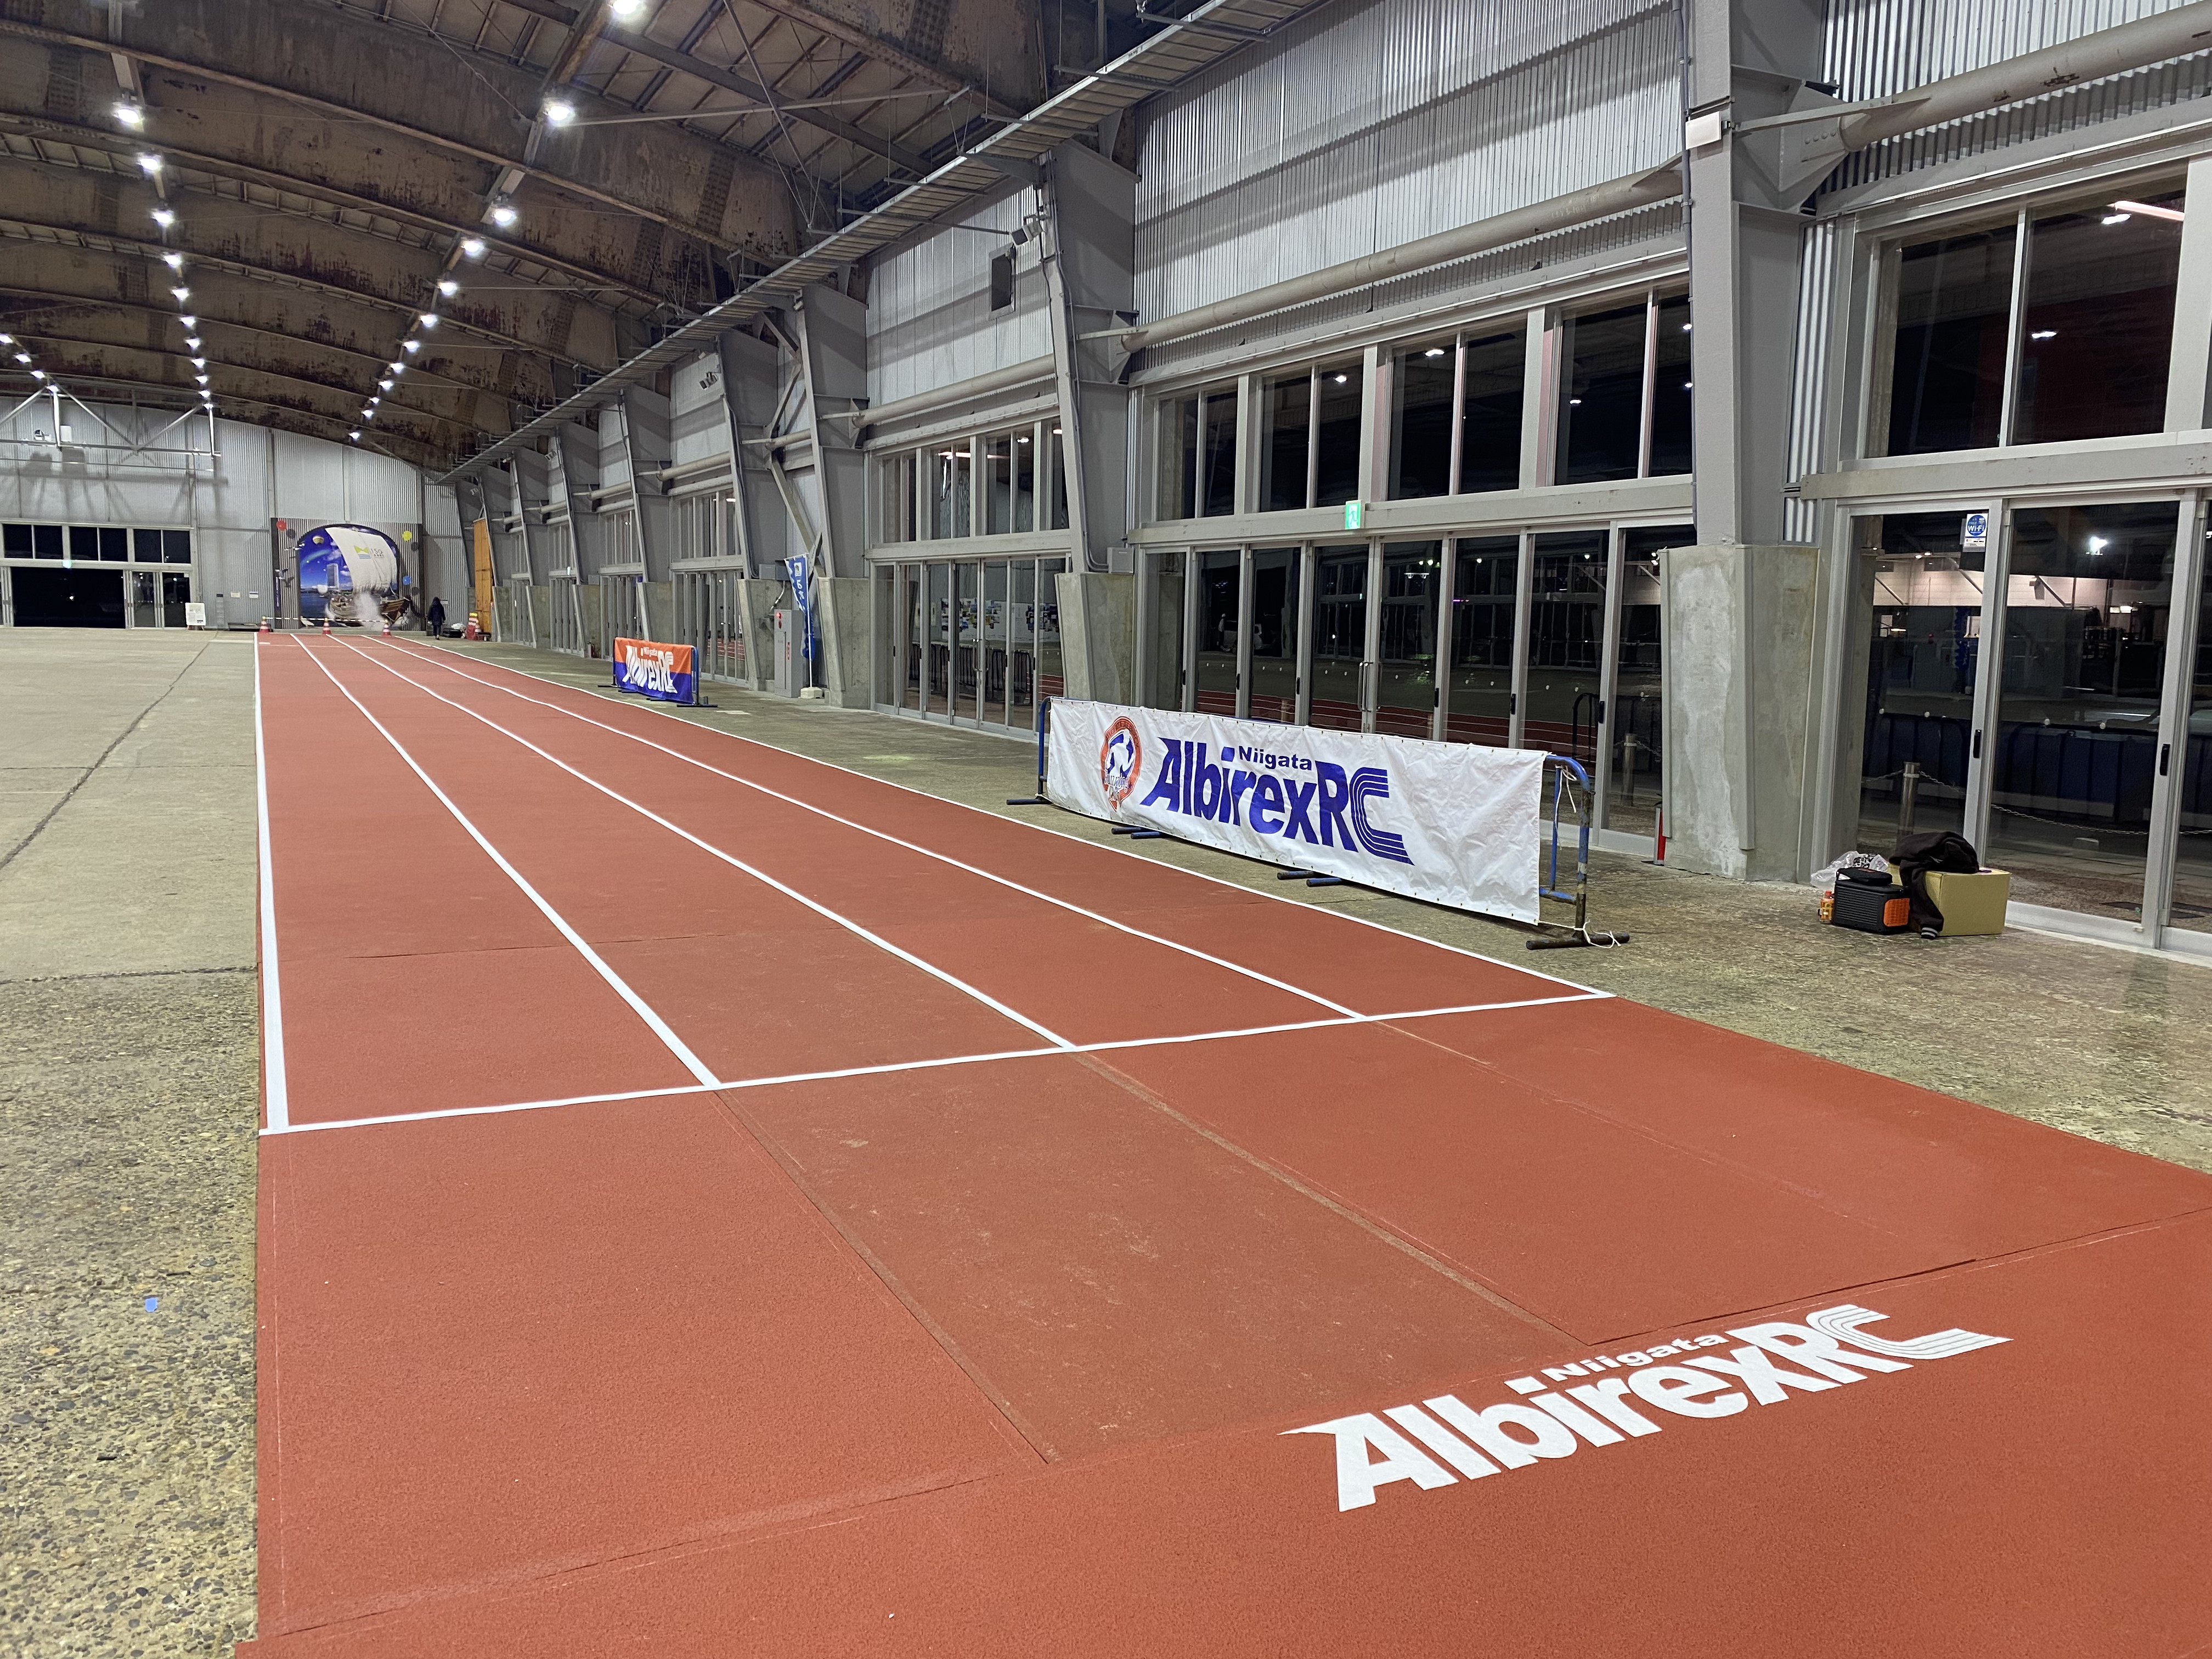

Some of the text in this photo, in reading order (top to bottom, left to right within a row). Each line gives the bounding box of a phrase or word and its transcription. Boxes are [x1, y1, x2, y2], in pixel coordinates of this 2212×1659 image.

[1139, 737, 1415, 866] AlbirexRC
[1239, 746, 1312, 771] Niigata
[1540, 1334, 1730, 1382] Niigata
[1276, 1304, 2015, 1513] AlbirexRC
